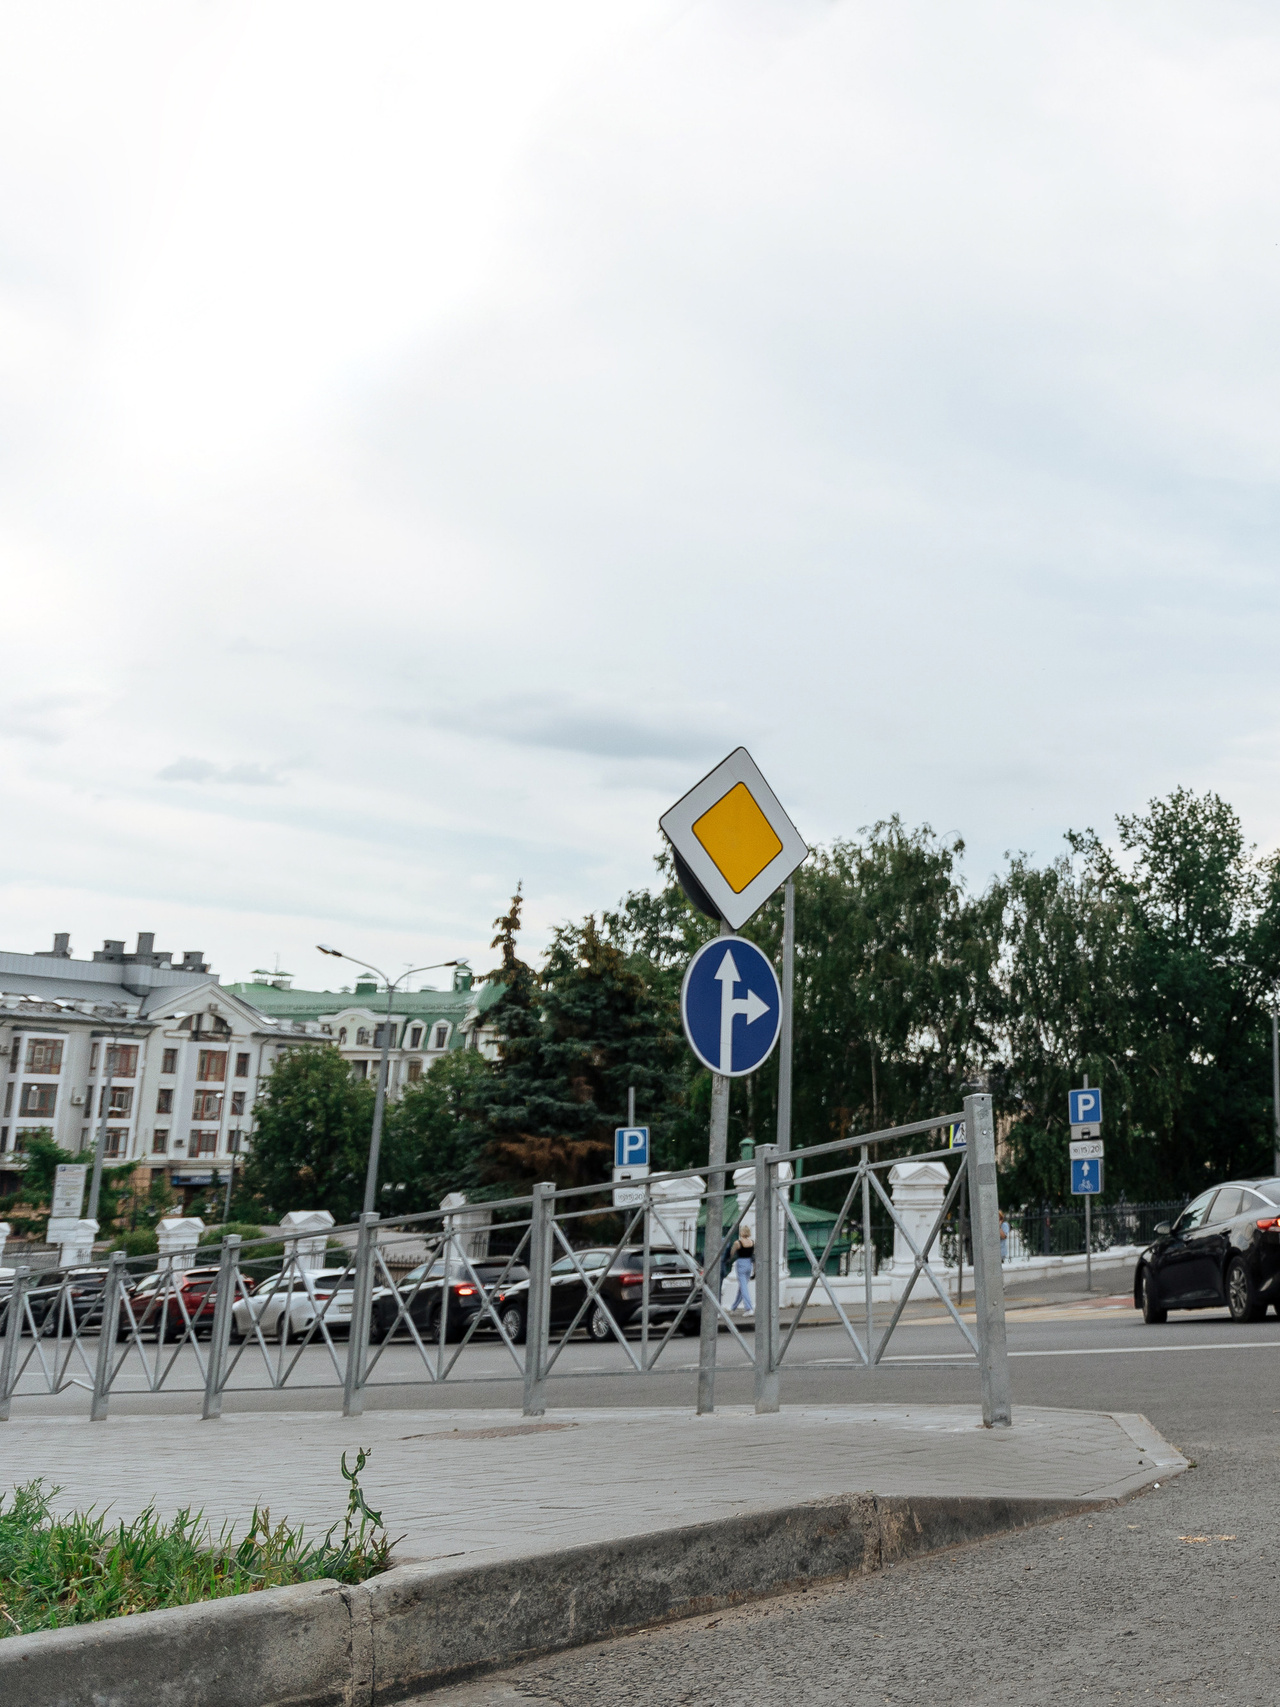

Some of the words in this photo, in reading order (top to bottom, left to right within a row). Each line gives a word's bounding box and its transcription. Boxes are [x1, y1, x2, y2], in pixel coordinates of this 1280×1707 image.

[1078, 1094, 1095, 1121] P
[623, 1131, 644, 1164] P
[1090, 1145, 1100, 1154] 20
